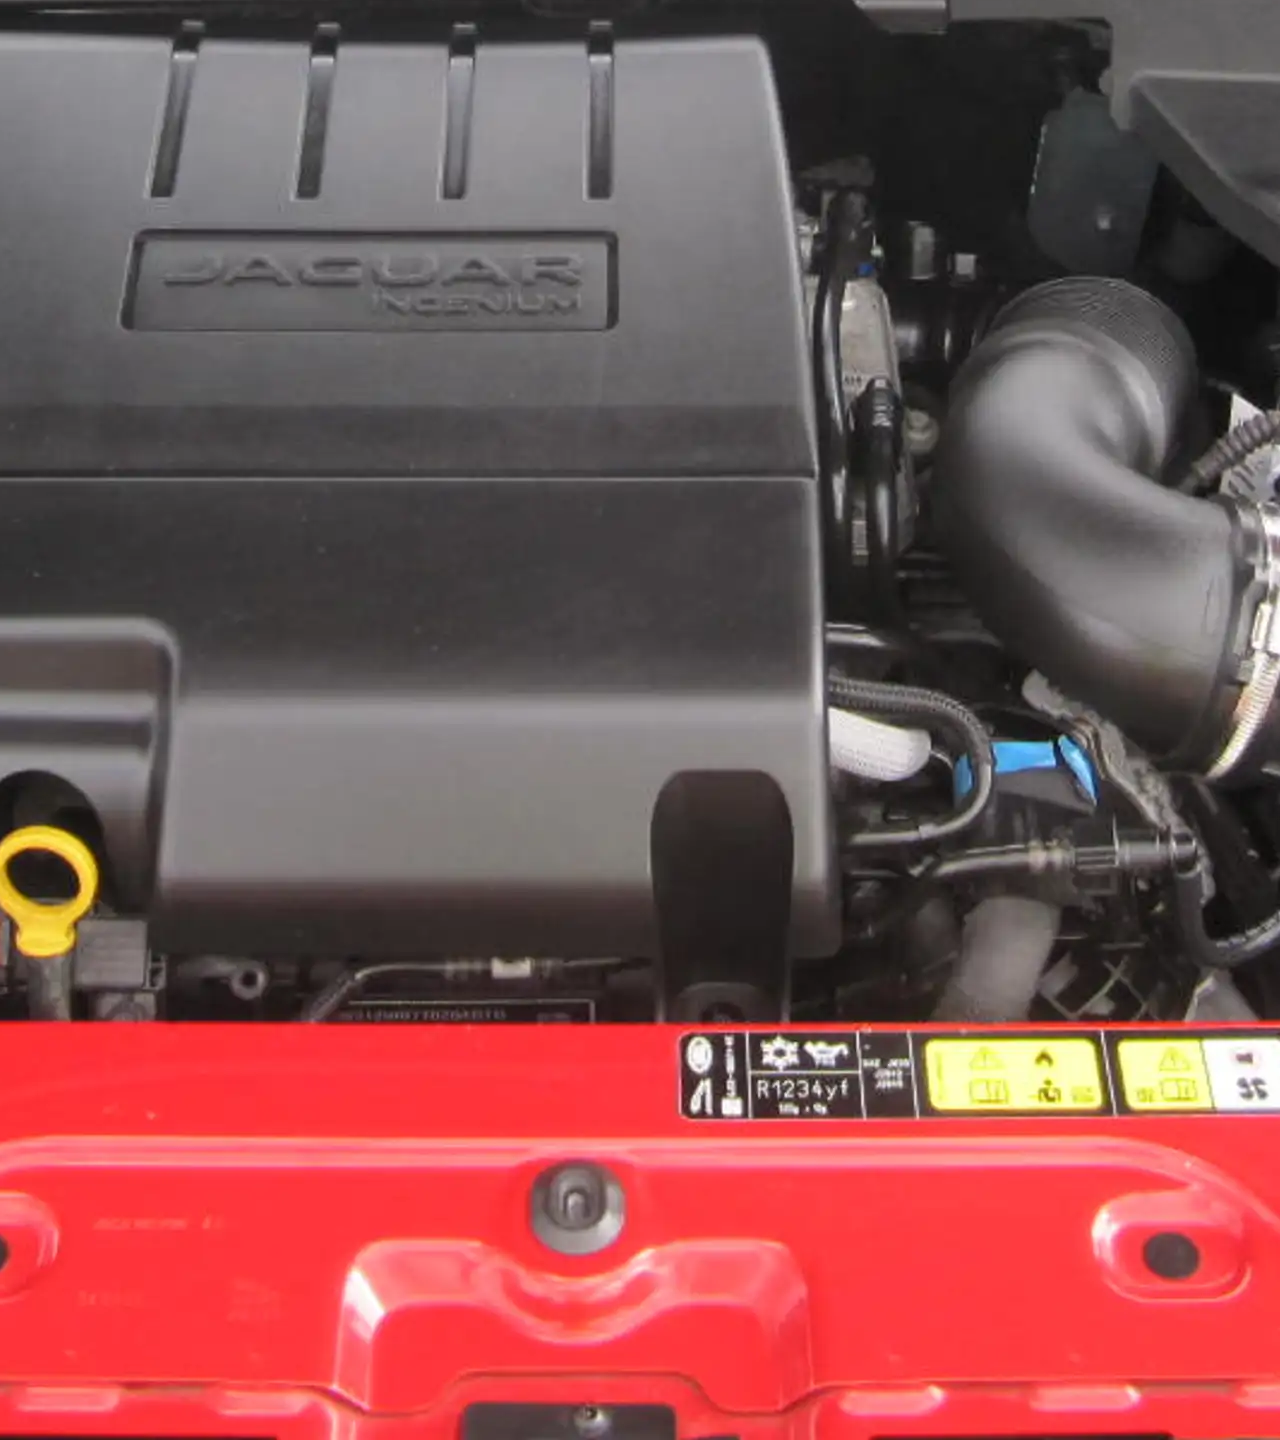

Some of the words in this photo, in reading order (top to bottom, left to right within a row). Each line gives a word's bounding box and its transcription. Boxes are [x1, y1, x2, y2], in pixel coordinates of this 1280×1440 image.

[161, 254, 583, 287] JAGUAR
[368, 289, 583, 316] INGENIUM
[757, 1079, 848, 1101] R1234yf
